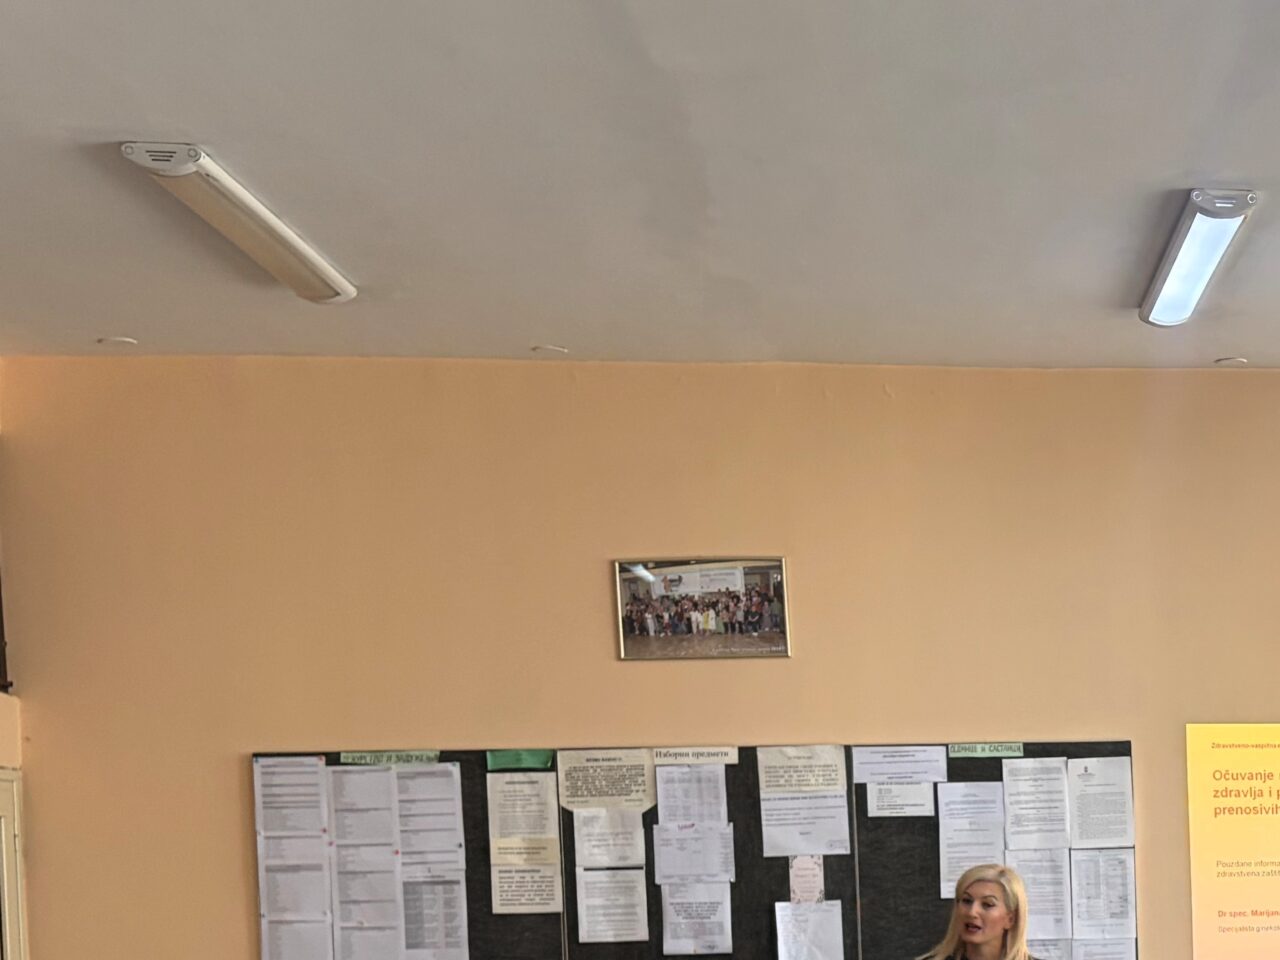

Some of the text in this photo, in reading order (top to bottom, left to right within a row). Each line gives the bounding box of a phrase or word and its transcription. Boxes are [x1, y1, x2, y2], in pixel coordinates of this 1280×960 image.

[1212, 769, 1275, 783] Očuvanje
[1212, 786, 1264, 800] zdravlja
[1215, 860, 1253, 868] Pouzdane
[1216, 870, 1261, 878] zdravstvena
[1217, 910, 1228, 918] Dr
